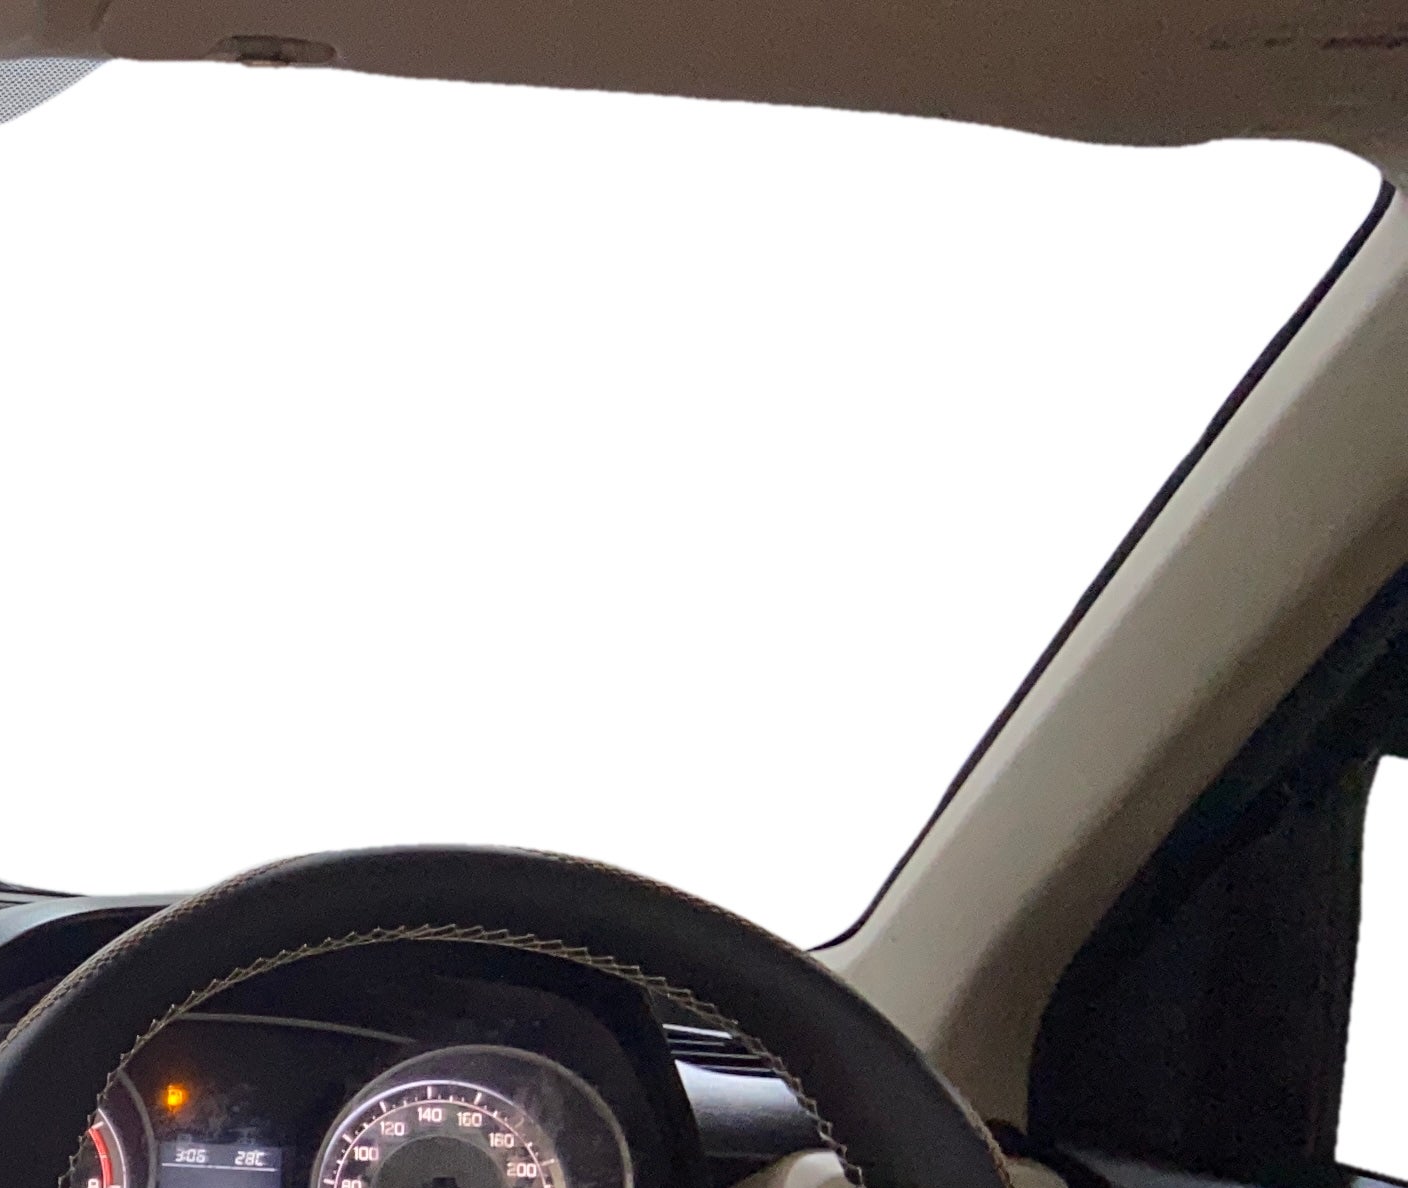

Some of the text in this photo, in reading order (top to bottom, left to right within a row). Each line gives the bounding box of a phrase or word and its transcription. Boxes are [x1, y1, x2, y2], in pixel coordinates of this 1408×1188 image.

[417, 1107, 442, 1122] 140
[456, 1111, 482, 1127] 160
[380, 1121, 405, 1137] 120
[489, 1132, 515, 1148] 180
[354, 1145, 379, 1161] 100
[507, 1162, 537, 1178] 200
